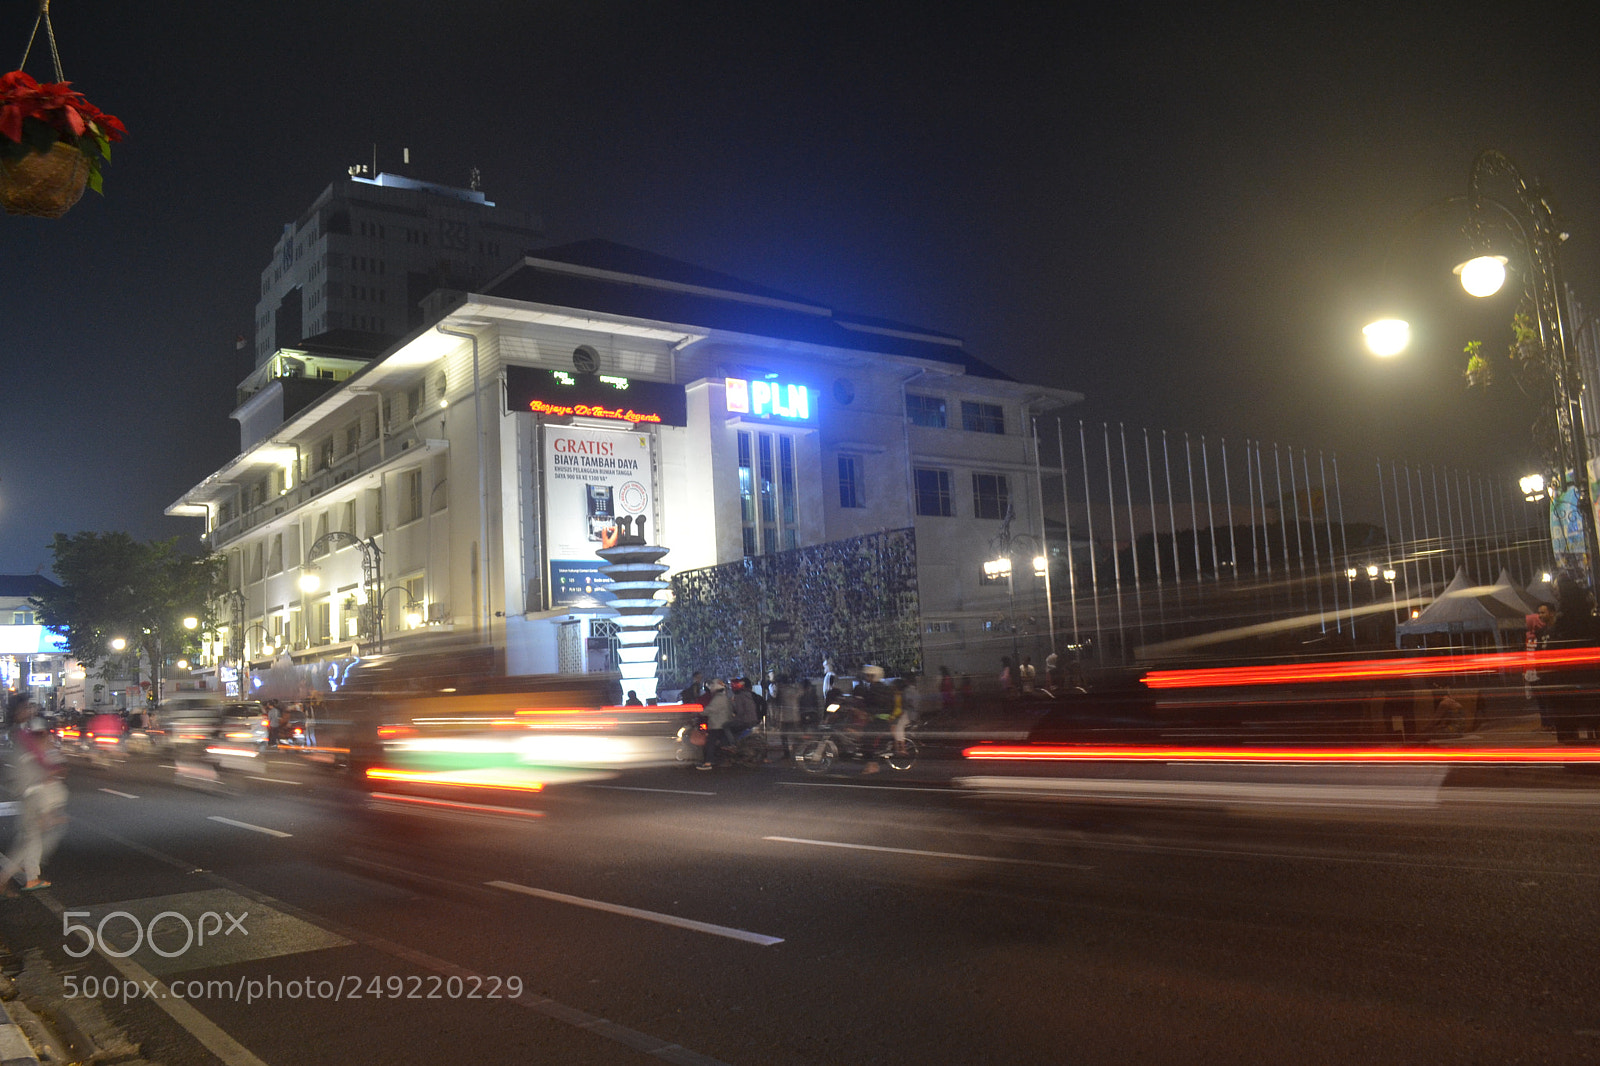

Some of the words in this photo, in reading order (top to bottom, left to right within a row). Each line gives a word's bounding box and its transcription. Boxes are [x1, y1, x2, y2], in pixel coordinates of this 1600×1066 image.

[752, 380, 809, 419] PLN
[554, 438, 613, 456] GRATIS!
[554, 454, 579, 466] BIAYA
[580, 456, 615, 469] TAMBAH
[617, 458, 638, 470] DAYA
